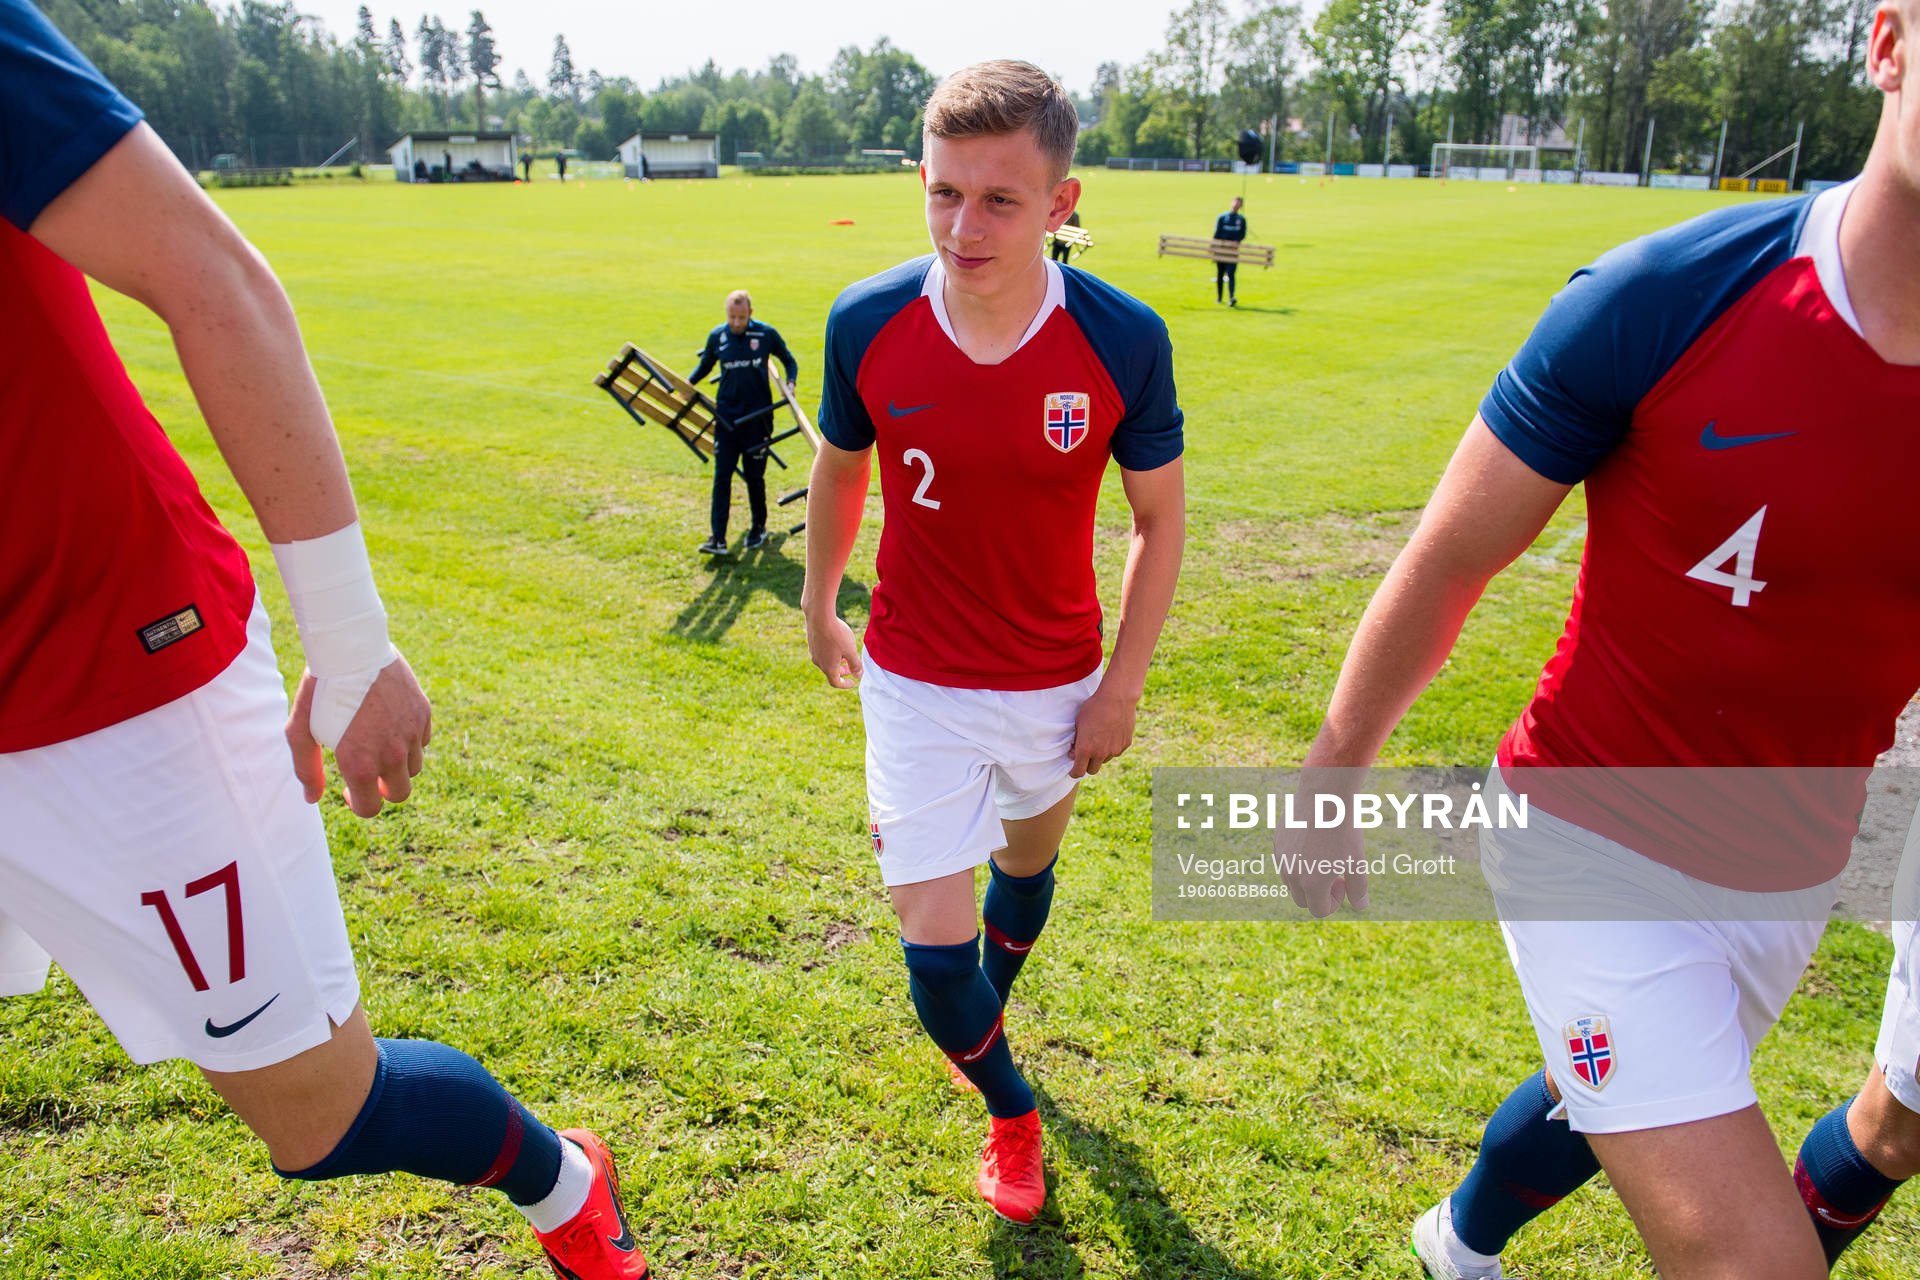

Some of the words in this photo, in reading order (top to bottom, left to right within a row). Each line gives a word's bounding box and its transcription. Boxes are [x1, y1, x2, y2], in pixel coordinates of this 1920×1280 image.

[903, 448, 941, 511] 2
[1685, 503, 1768, 607] 4
[140, 860, 246, 992] 17
